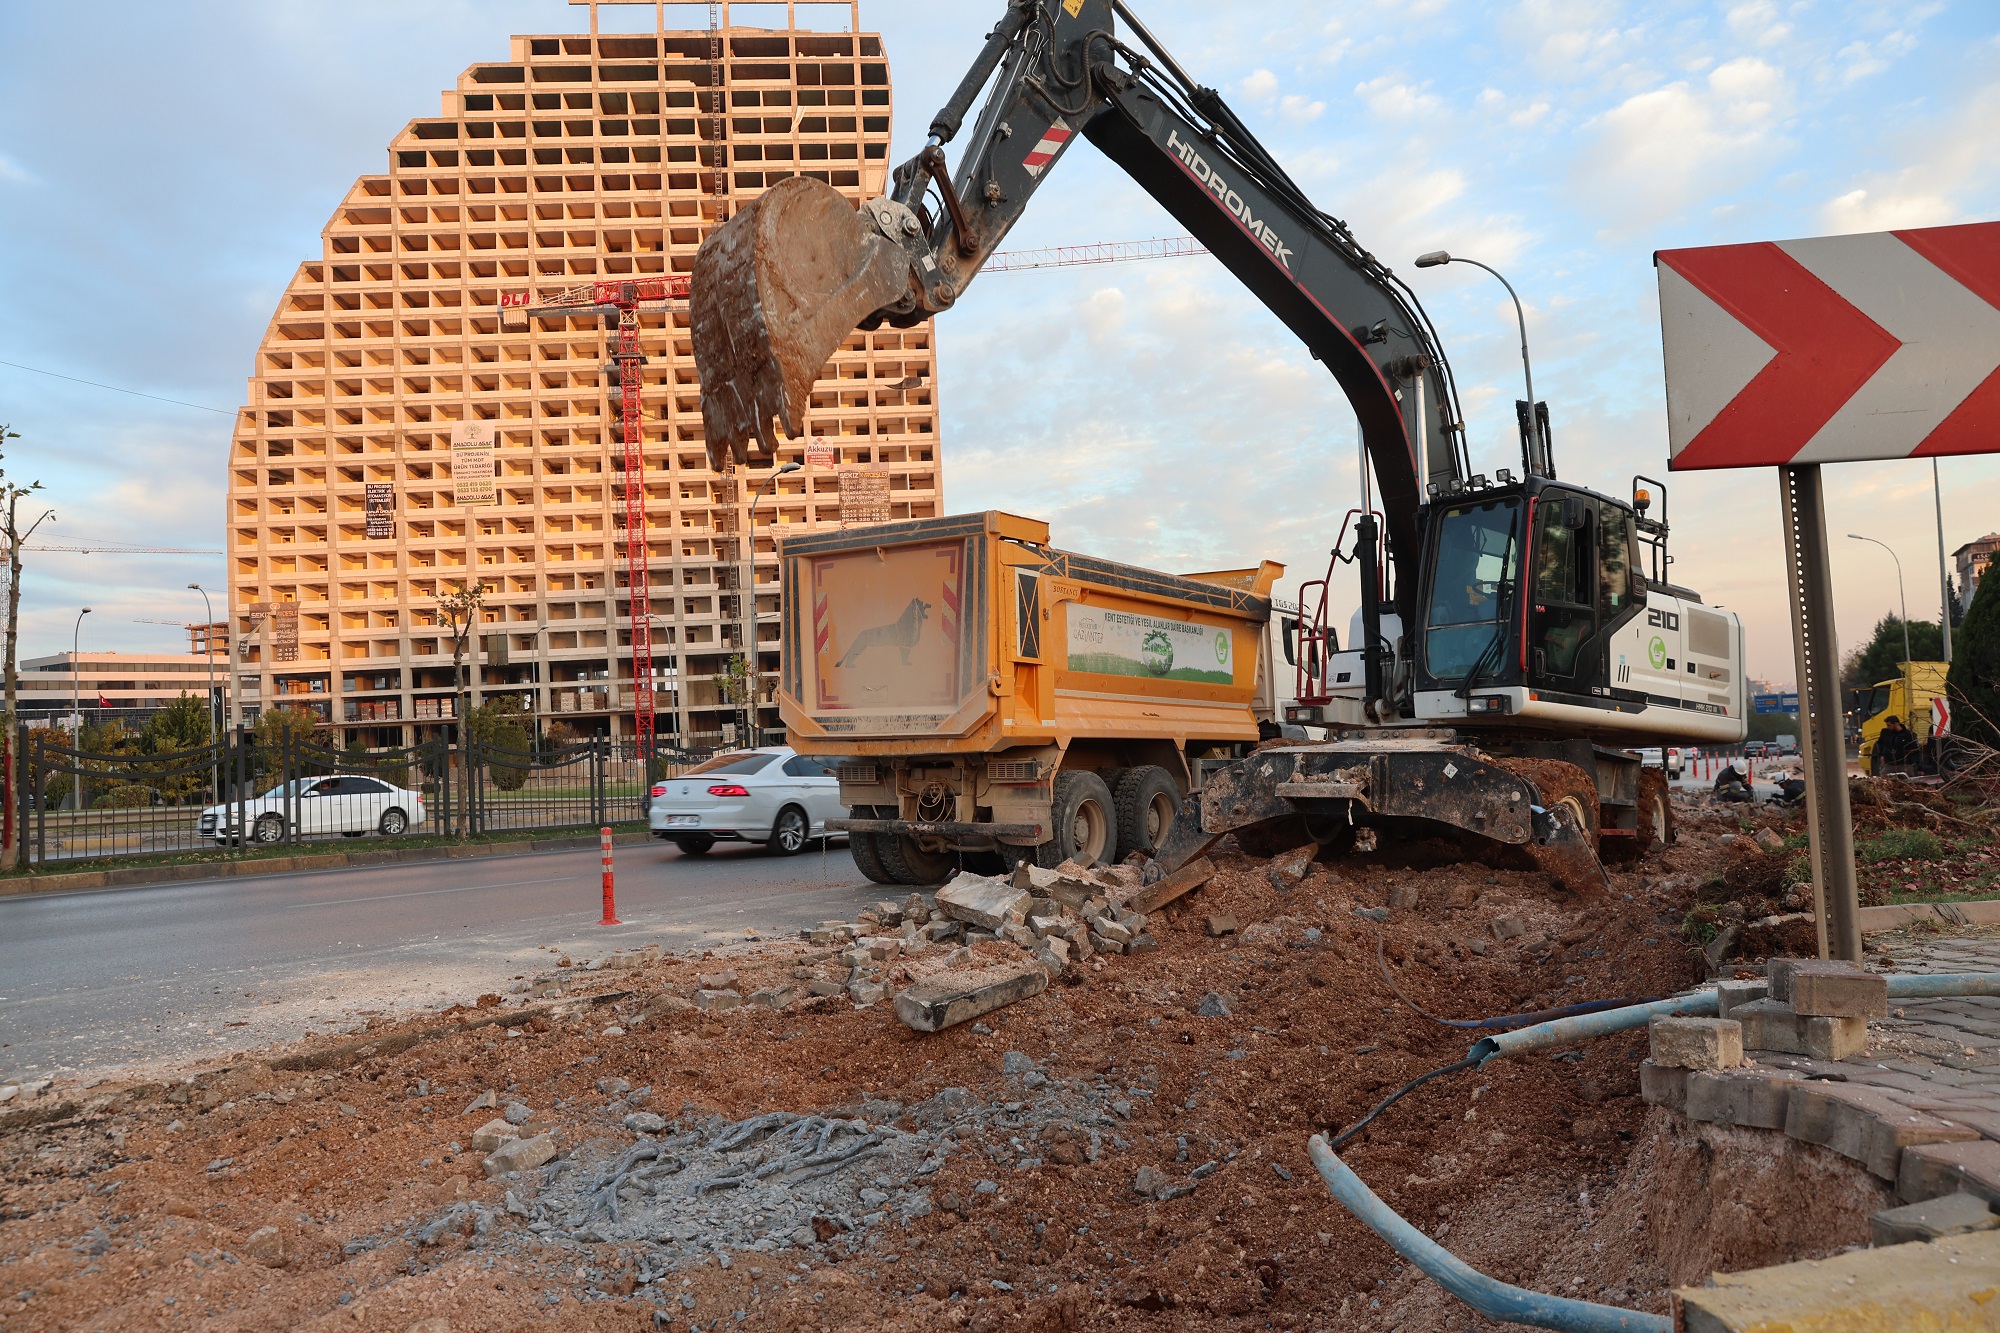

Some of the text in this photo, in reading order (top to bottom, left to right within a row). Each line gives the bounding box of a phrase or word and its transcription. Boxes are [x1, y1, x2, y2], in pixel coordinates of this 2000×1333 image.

[807, 445, 833, 453] Akkuzu
[1104, 612, 1116, 623] KENT
[1116, 613, 1135, 625] ESTETİĞİ
[1135, 617, 1141, 627] VE
[1153, 620, 1171, 631] ALANLAR
[1171, 621, 1182, 632] DAİRE
[1647, 607, 1679, 632] 210
